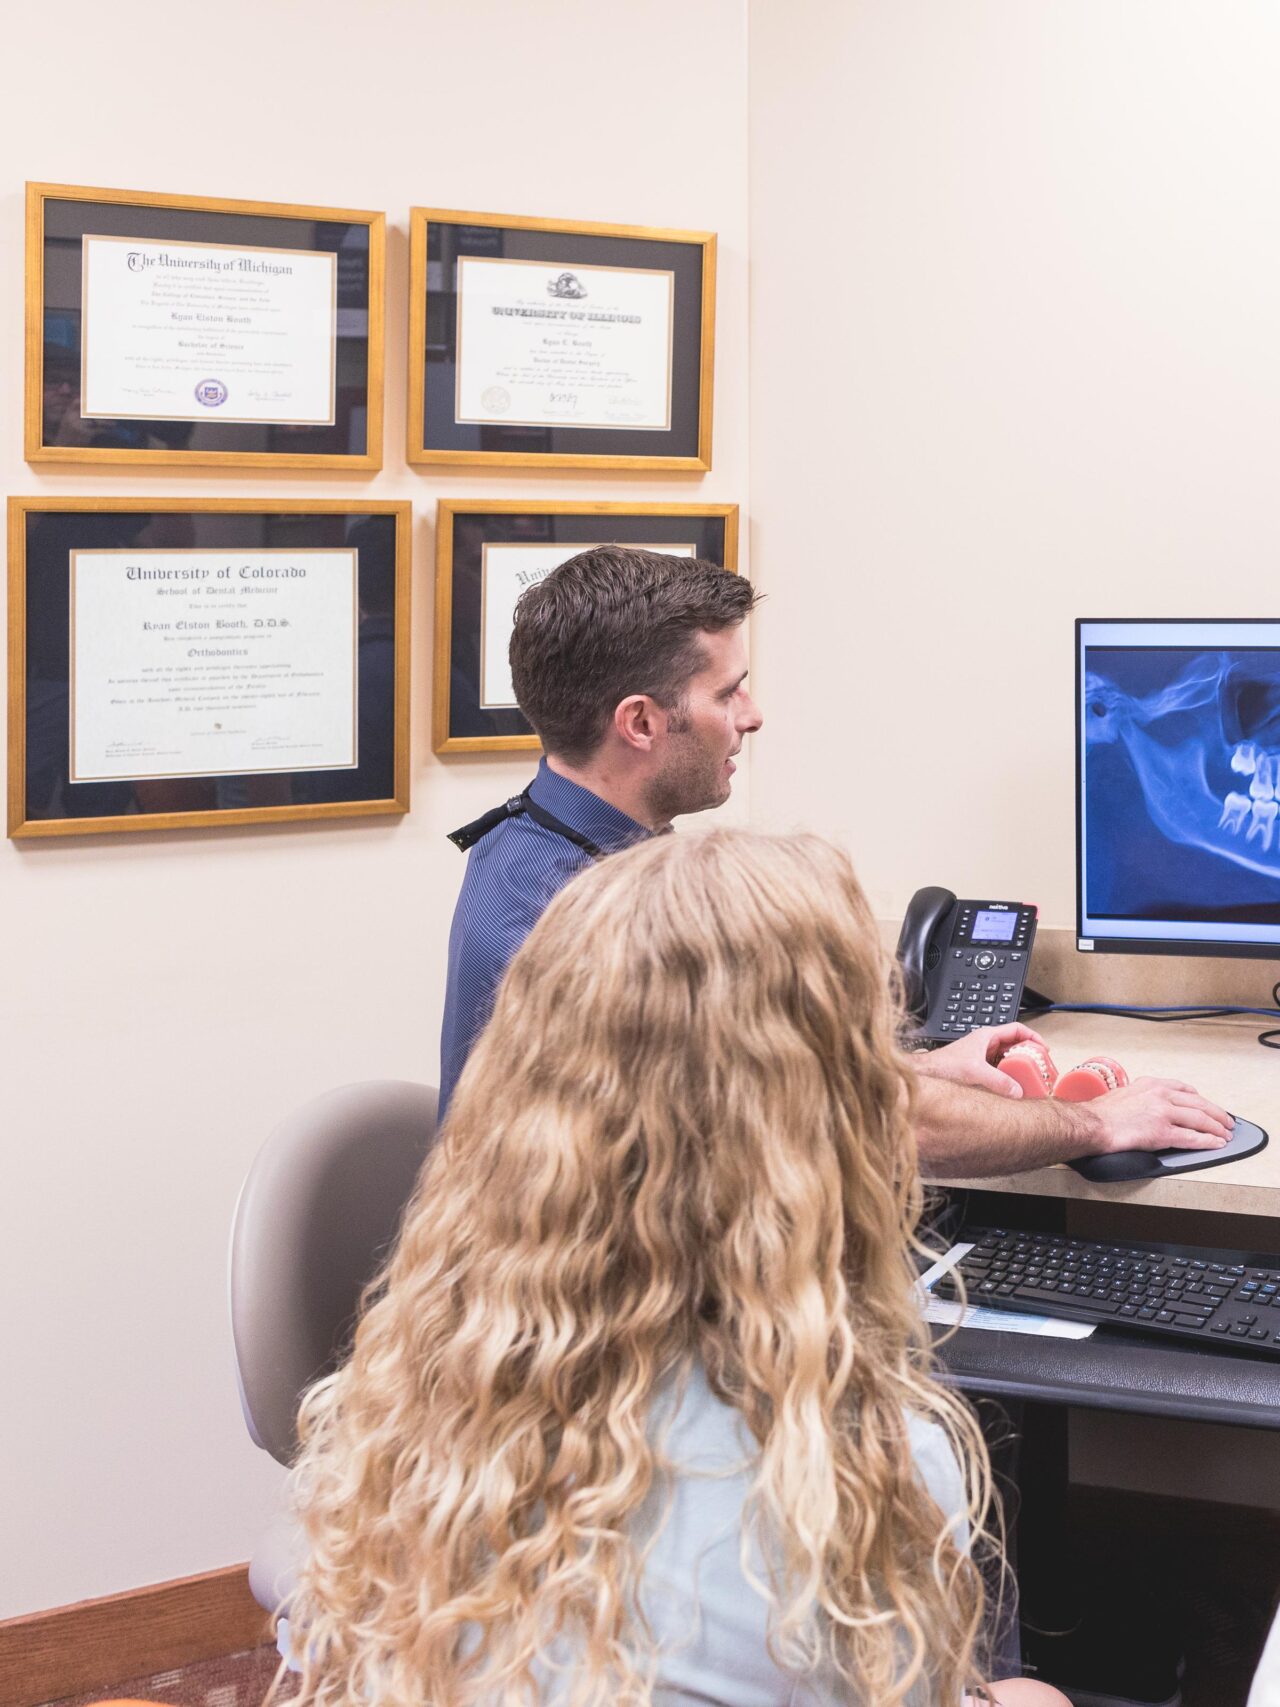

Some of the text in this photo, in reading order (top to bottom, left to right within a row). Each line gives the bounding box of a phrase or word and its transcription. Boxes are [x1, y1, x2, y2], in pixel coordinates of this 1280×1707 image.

[127, 252, 293, 276] The University of Michigan
[126, 566, 307, 581] University of Colorado
[156, 588, 188, 596] School
[192, 587, 201, 595] of
[205, 587, 236, 596] Dental
[187, 649, 249, 658] Orthodontics
